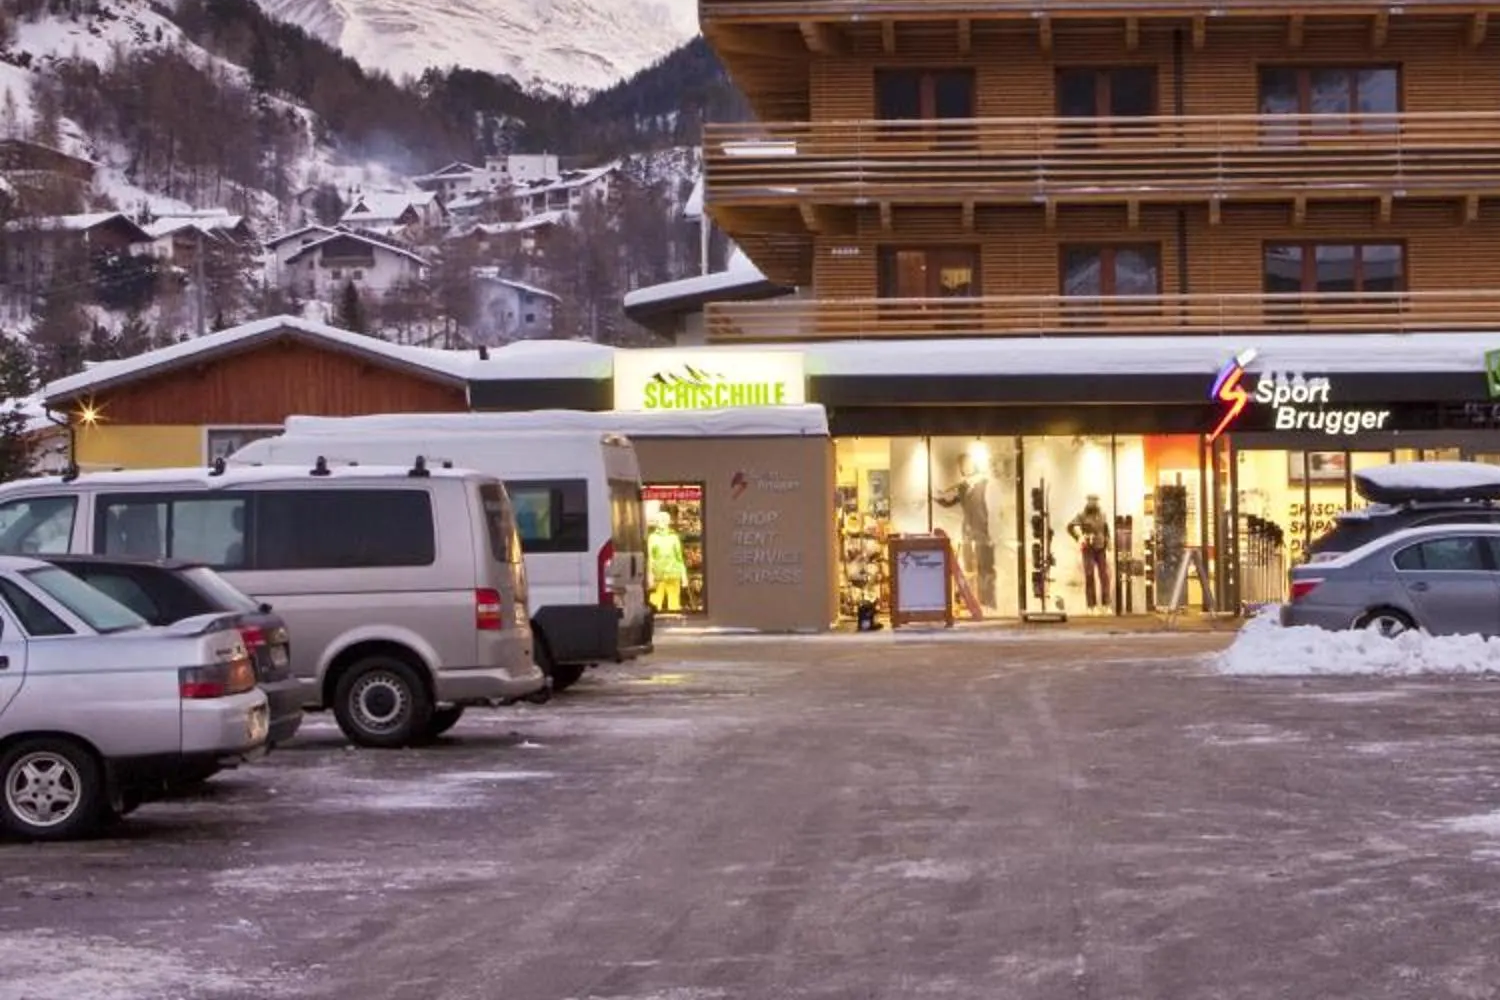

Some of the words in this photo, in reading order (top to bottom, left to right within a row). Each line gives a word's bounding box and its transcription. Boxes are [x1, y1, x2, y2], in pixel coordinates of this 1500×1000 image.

[643, 381, 786, 409] SCHISCHULE
[1255, 378, 1331, 409] Sport
[1275, 406, 1390, 435] Brugger
